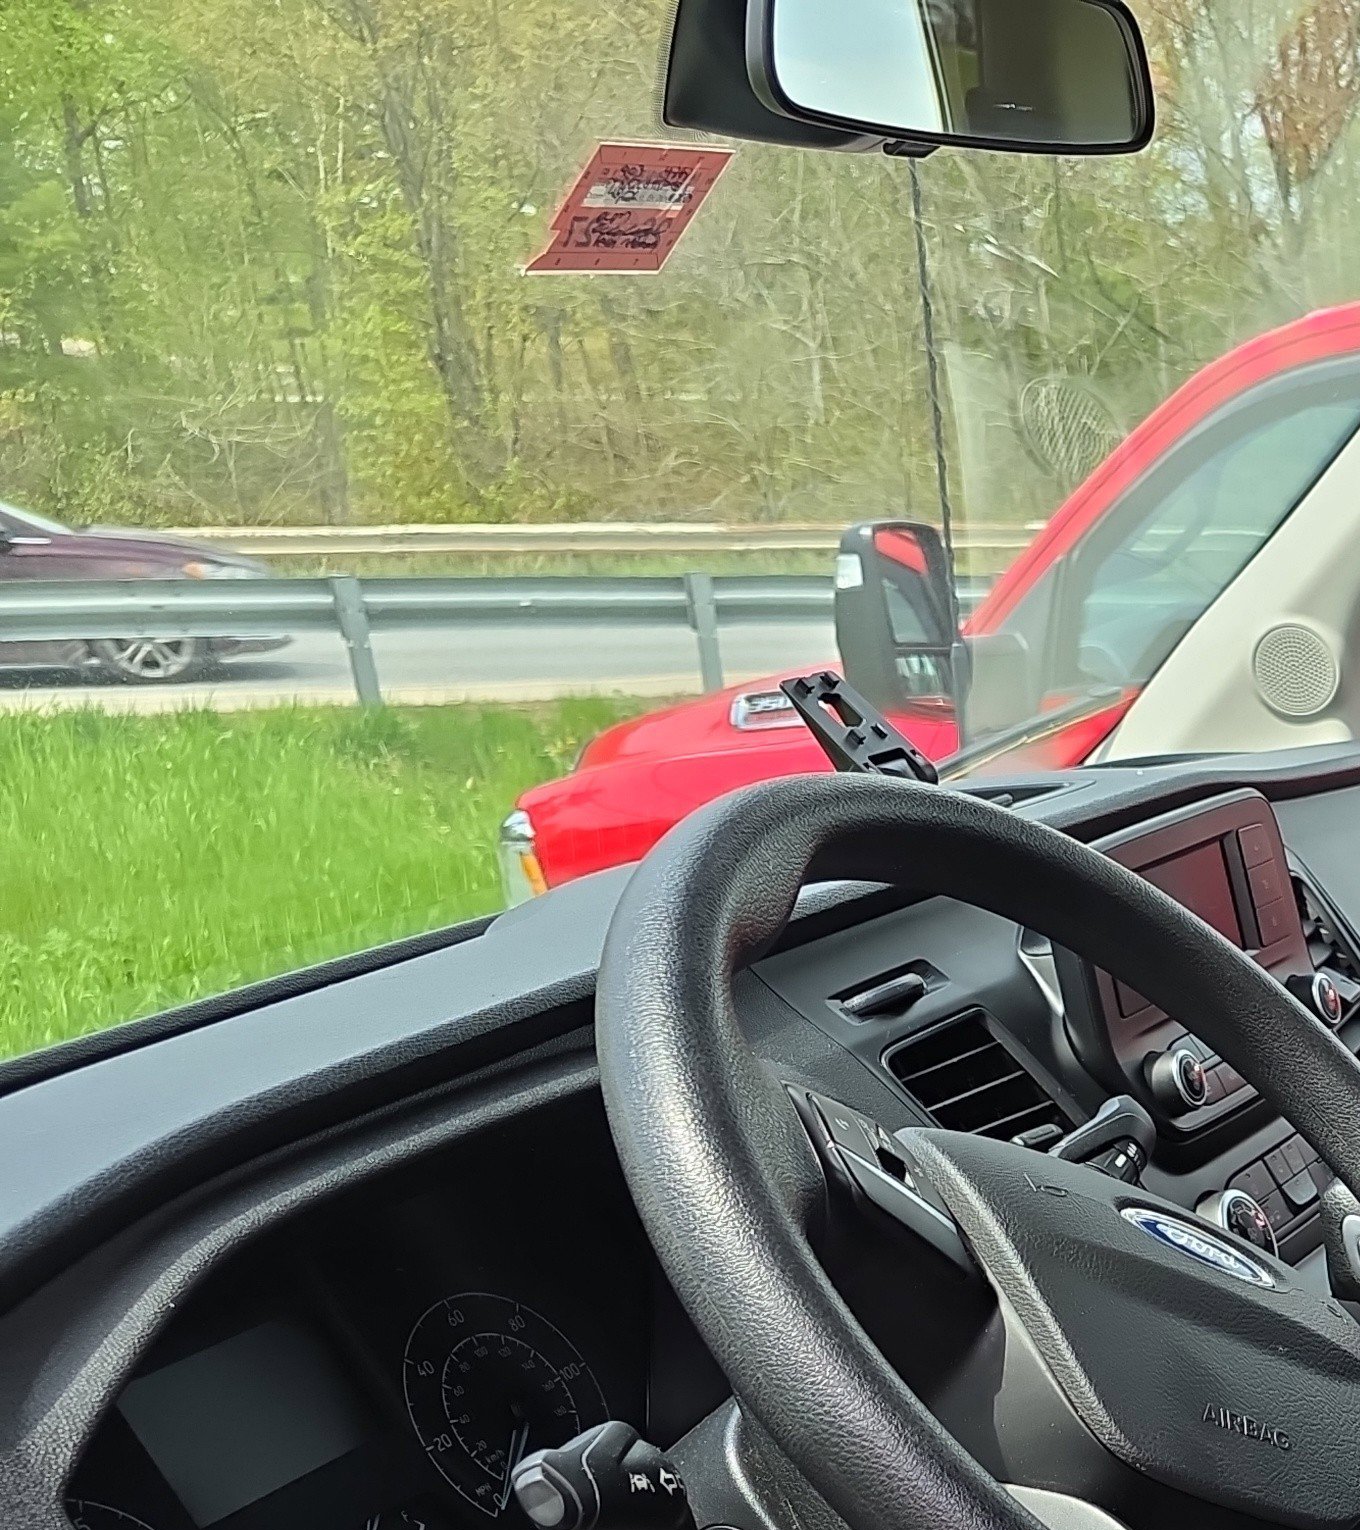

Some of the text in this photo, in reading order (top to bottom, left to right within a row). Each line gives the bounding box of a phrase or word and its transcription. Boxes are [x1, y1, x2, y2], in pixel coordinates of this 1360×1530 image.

[448, 1309, 465, 1327] 60
[509, 1314, 526, 1332] 80
[417, 1360, 435, 1377] 40
[559, 1362, 581, 1382] 100
[1202, 1402, 1290, 1450] AIRBAG
[432, 1432, 453, 1452] 20
[475, 1483, 492, 1497] MPH
